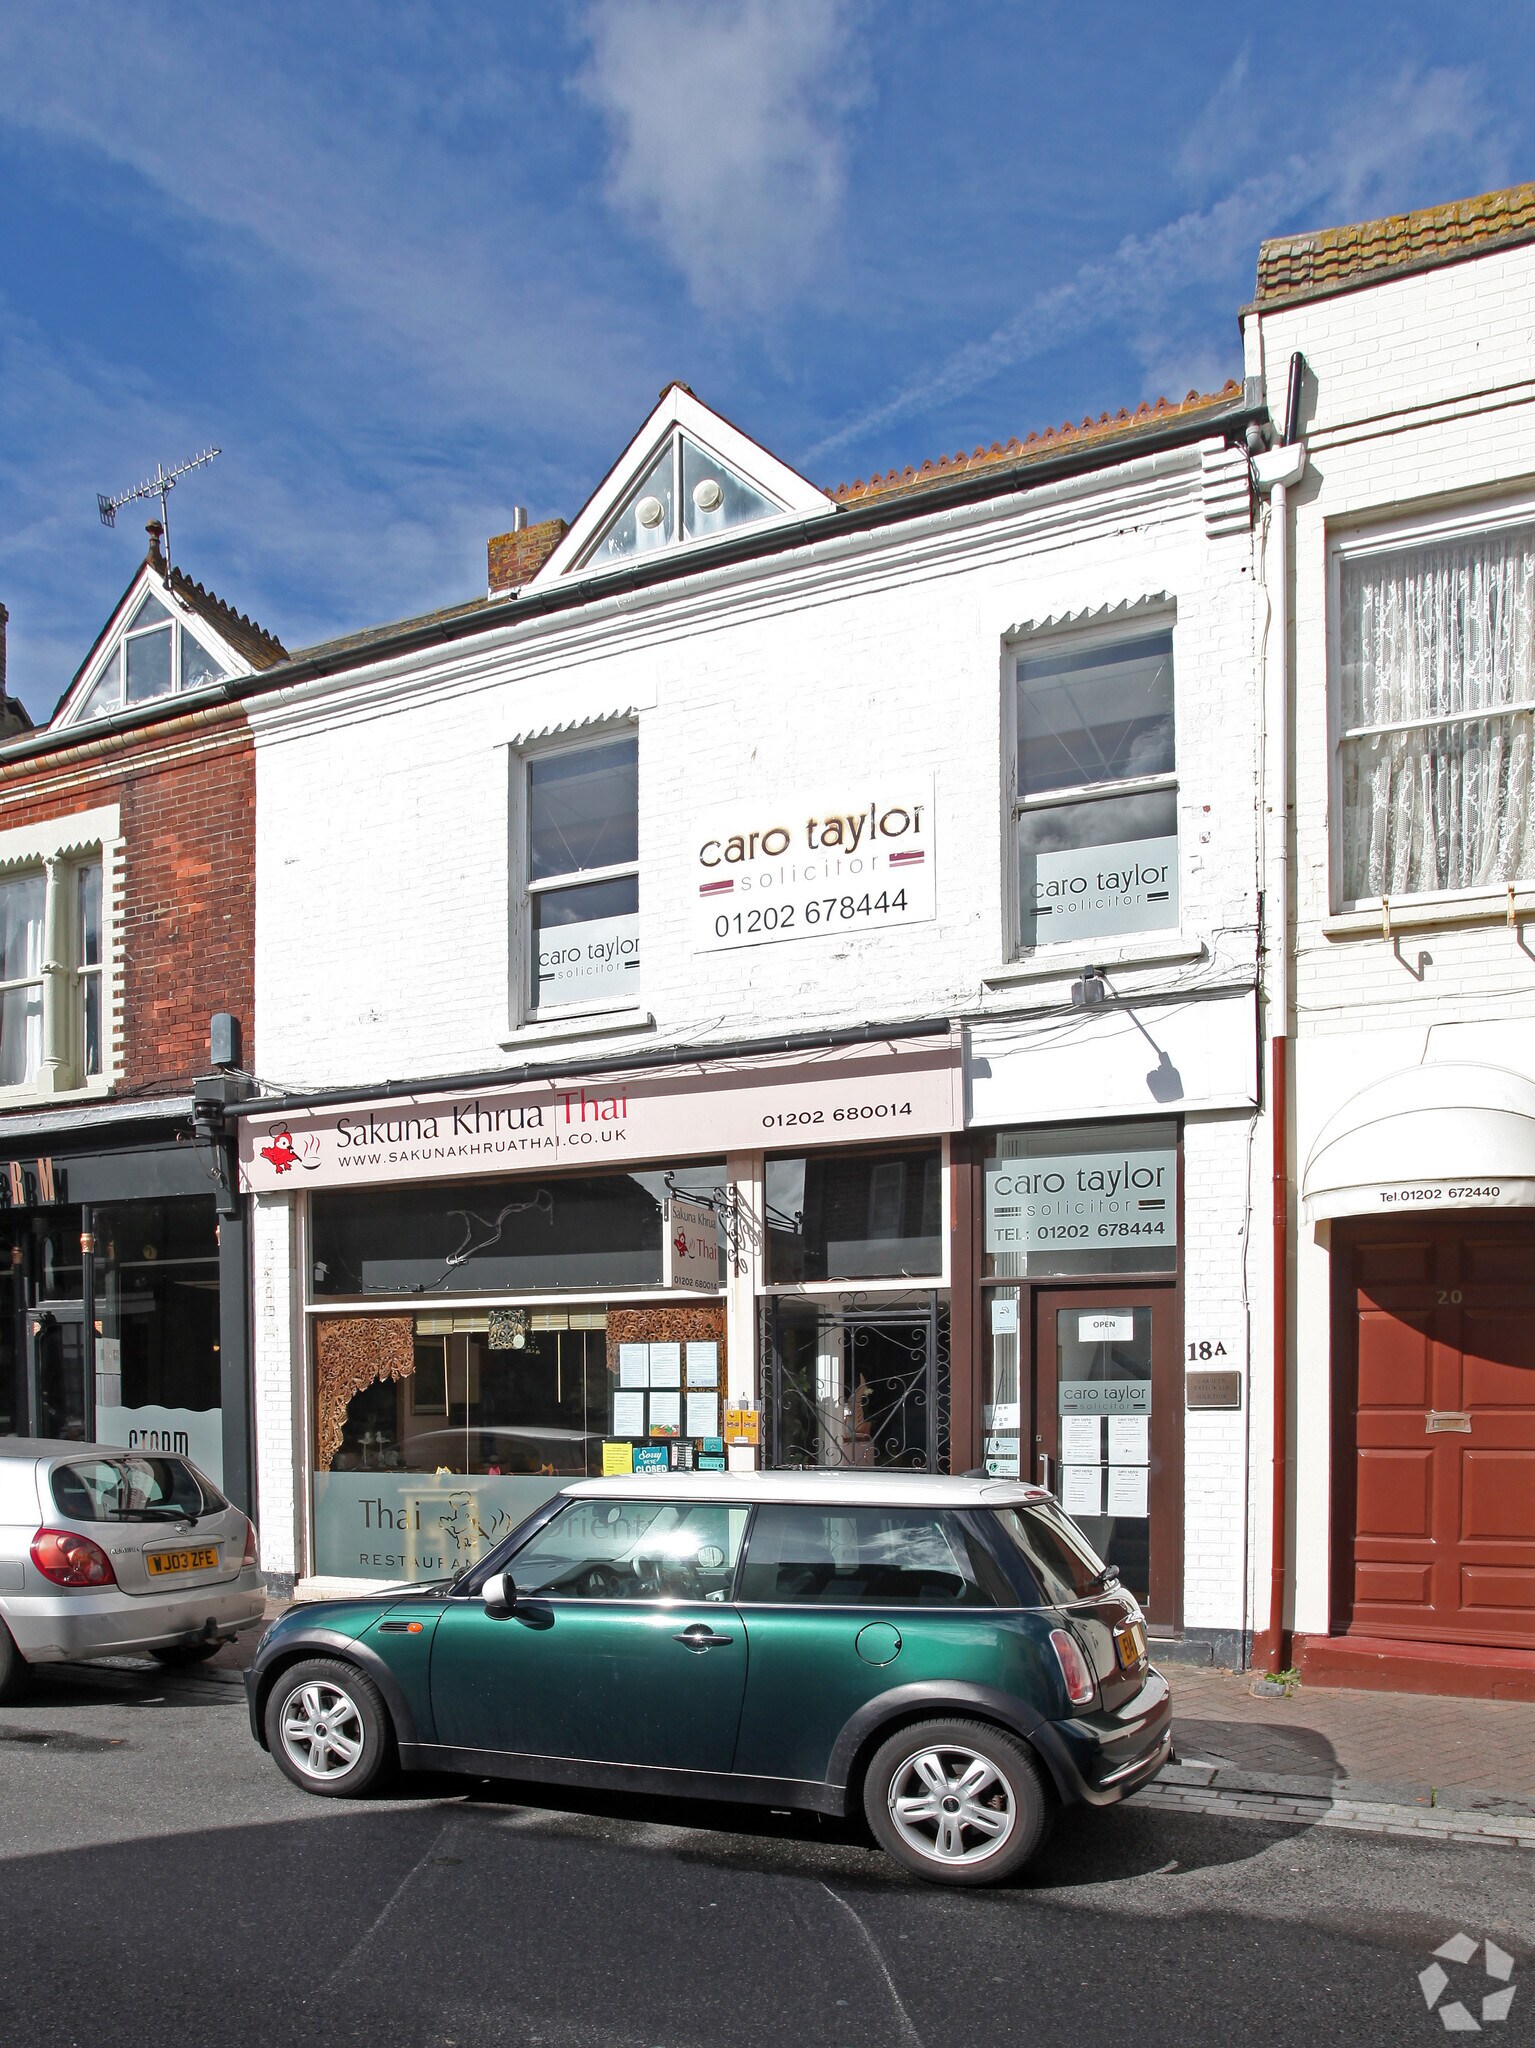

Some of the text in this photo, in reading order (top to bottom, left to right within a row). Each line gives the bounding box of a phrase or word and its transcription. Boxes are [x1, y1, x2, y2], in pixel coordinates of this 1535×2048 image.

[699, 802, 925, 868] caro taylor
[740, 855, 879, 892] solicitor
[1029, 863, 1169, 899] caro taylor
[714, 888, 909, 938] 01202 678444
[1056, 893, 1142, 914] solicitor
[538, 935, 640, 968] caro taylor
[556, 961, 622, 980] solicitor
[336, 1086, 629, 1149] Sakuna Khrua Thai
[762, 1102, 913, 1128] 01202 680014
[337, 1128, 628, 1168] WWW.SAKUNAKHRUATHAI.CO.UK
[993, 1160, 1166, 1198] caro taylor
[1448, 1186, 1501, 1199] 672440
[672, 1205, 717, 1229] Sakuna Khrua
[1026, 1198, 1131, 1217] solicitor
[1037, 1224, 1090, 1240] 01202
[1097, 1220, 1166, 1237] 678444
[696, 1238, 717, 1261] Thai
[674, 1275, 718, 1291] 01202 680014
[1436, 1289, 1463, 1305] 20
[1092, 1320, 1116, 1328] OPEN
[1186, 1340, 1228, 1361] 18A
[1063, 1384, 1146, 1403] caro taylor
[1079, 1401, 1130, 1411] solicitor
[638, 1449, 663, 1462] Sorry
[635, 1464, 668, 1474] CLOSED
[358, 1497, 421, 1531] Thai
[152, 1550, 214, 1571] WJ03 ZFE
